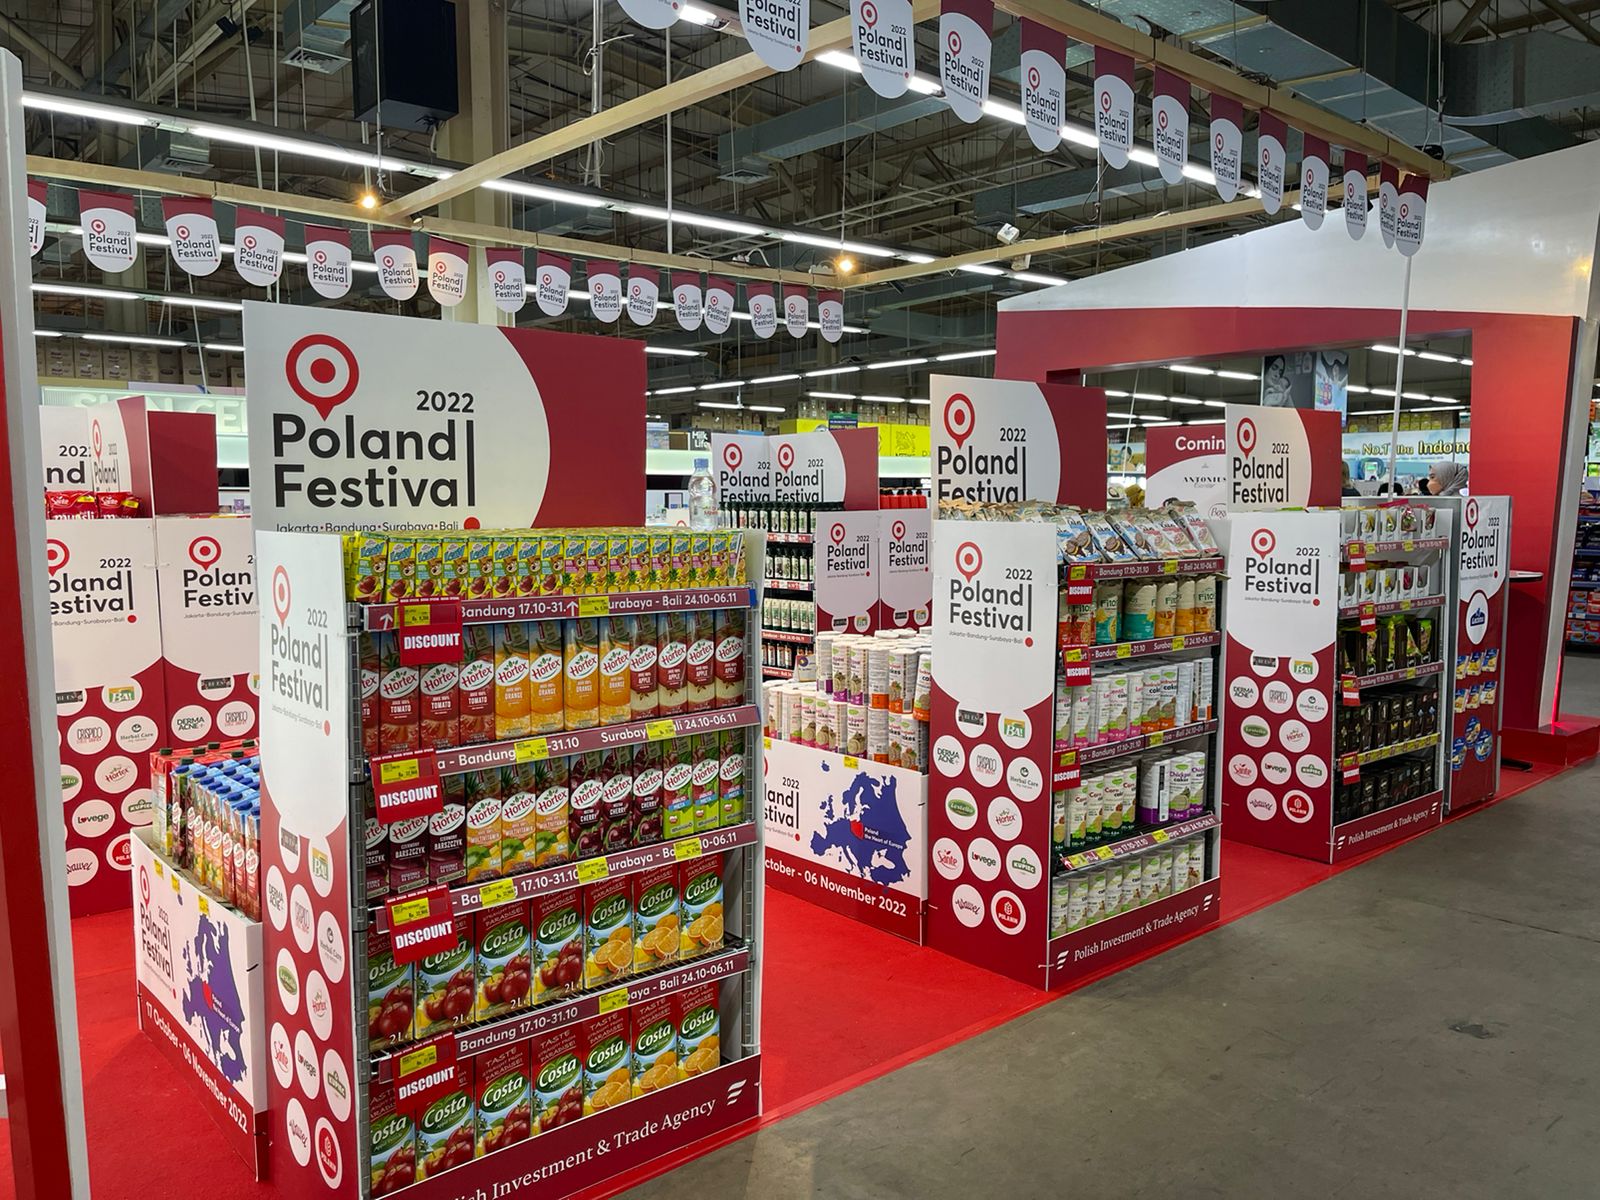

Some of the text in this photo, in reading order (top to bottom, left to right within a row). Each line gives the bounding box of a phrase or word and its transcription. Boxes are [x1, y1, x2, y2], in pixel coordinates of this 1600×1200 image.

[859, 26, 902, 51] Poland
[891, 24, 906, 35] 2022
[945, 52, 979, 82] Poland
[971, 56, 984, 67] 2022
[1026, 88, 1057, 111] Poland
[1049, 88, 1060, 97] 2022
[1099, 112, 1126, 131] Poland
[1156, 128, 1180, 149] Poland
[1214, 151, 1234, 167] Poland
[1398, 218, 1418, 230] Poland
[89, 233, 127, 245] Poland
[176, 240, 211, 249] Poland
[240, 248, 274, 263] Poland
[313, 264, 344, 275] Poland
[383, 268, 411, 277] Poland
[433, 273, 460, 285] Poland
[416, 390, 474, 413] 2022
[273, 413, 456, 461] Poland
[692, 430, 708, 440] Milk
[1000, 428, 1026, 442] 2022
[1175, 437, 1225, 451] Comin
[1272, 443, 1289, 454] 2022
[808, 459, 823, 467] 2022
[938, 445, 1017, 475] Poland
[1233, 457, 1284, 479] Poland
[721, 471, 769, 487] Poland
[775, 469, 819, 486] Poland
[439, 520, 459, 531] Bali
[889, 540, 924, 553] Poland
[1461, 532, 1495, 549] Poland
[827, 543, 865, 557] Poland
[1296, 548, 1320, 556] 2022
[100, 558, 131, 568] 2022
[1099, 568, 1123, 576] Bandung
[1246, 558, 1311, 575] Poland
[50, 571, 122, 592] oland
[184, 569, 251, 587] Polan
[1005, 568, 1032, 580] 2022
[185, 589, 254, 607] Festiv
[608, 593, 737, 609] urabaya Bali 24.10-06.11
[950, 579, 1023, 606] Poland
[307, 608, 327, 628] 2022
[271, 623, 321, 669] Poland
[404, 633, 460, 649] DISCOUNT
[662, 648, 685, 665] Hortex
[462, 667, 492, 687] Hortex
[498, 663, 527, 682] Hortex
[532, 660, 560, 679] Hortex
[383, 674, 417, 694] Hortex
[424, 670, 456, 691] Hortex
[469, 696, 487, 704] TOMATO
[504, 690, 522, 699] ORANGE
[391, 704, 411, 713] TOMATO
[177, 718, 204, 726] DERMA
[459, 713, 737, 766] Bandung Surabay 24.10-06.11
[938, 748, 959, 758] DERMA
[105, 767, 129, 782] Hortex
[782, 777, 799, 789] 2022
[380, 785, 438, 808] DISCOUNT
[574, 784, 601, 805] Hortex
[432, 809, 463, 831] Hortex
[469, 804, 499, 827] Hortex
[580, 813, 597, 822] CHERRY
[995, 814, 1016, 826] Hortex
[1348, 830, 1364, 844] Polish
[1365, 820, 1393, 839] Investment
[608, 850, 653, 871] urabaya
[686, 876, 717, 900] Costa
[765, 860, 907, 917] ctober 06 November 2022
[592, 897, 626, 924] Costa
[140, 903, 168, 951] Poland
[395, 922, 452, 949] DISCOUNT
[1074, 904, 1199, 961] Polish Investment & Trade Agency
[483, 925, 524, 952] Costa
[460, 961, 734, 1052] Bandung 17.10-31.10 Bali 24.10-06.11
[638, 1024, 671, 1050] Costa
[146, 1002, 247, 1134] 17 October 06 November 2022
[399, 1067, 455, 1100] DISCOUNT
[483, 1077, 523, 1107] Costa
[424, 1096, 467, 1128] Costa
[492, 1099, 716, 1200] Investment & Trade Agency
